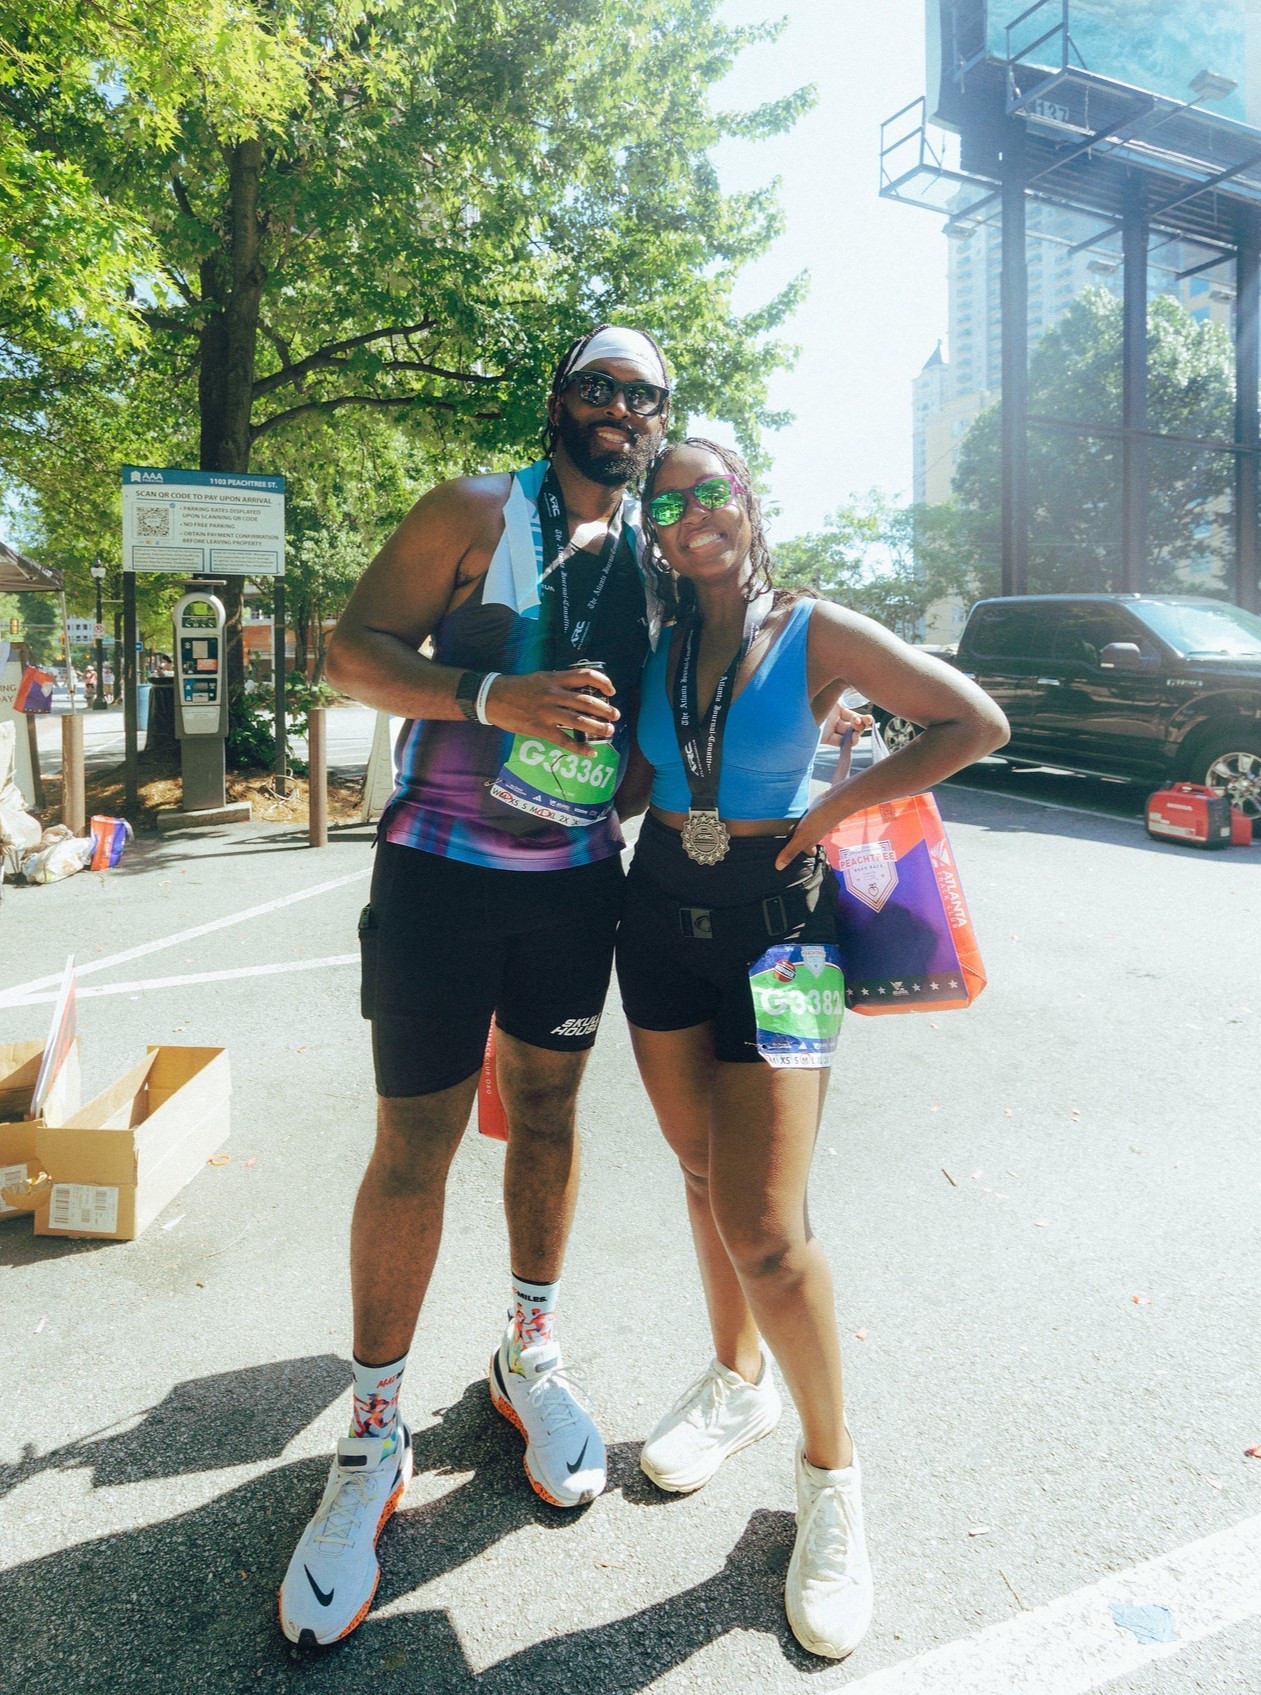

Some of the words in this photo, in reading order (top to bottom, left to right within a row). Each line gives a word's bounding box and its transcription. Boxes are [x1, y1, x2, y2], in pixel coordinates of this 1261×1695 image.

[142, 472, 164, 480] AAA
[228, 479, 266, 488] PEACHTREE
[242, 496, 272, 504] ARRIVAL
[715, 676, 729, 702] Atlanta
[680, 685, 689, 709] Atlanta
[681, 711, 691, 726] The
[519, 740, 614, 788] G33367
[509, 798, 519, 807] XS
[840, 852, 896, 868] PEACHTREE
[937, 872, 950, 901] TRACK
[947, 905, 958, 929] CLUB
[943, 870, 968, 928] ATLANTA
[780, 1056, 791, 1065] XS
